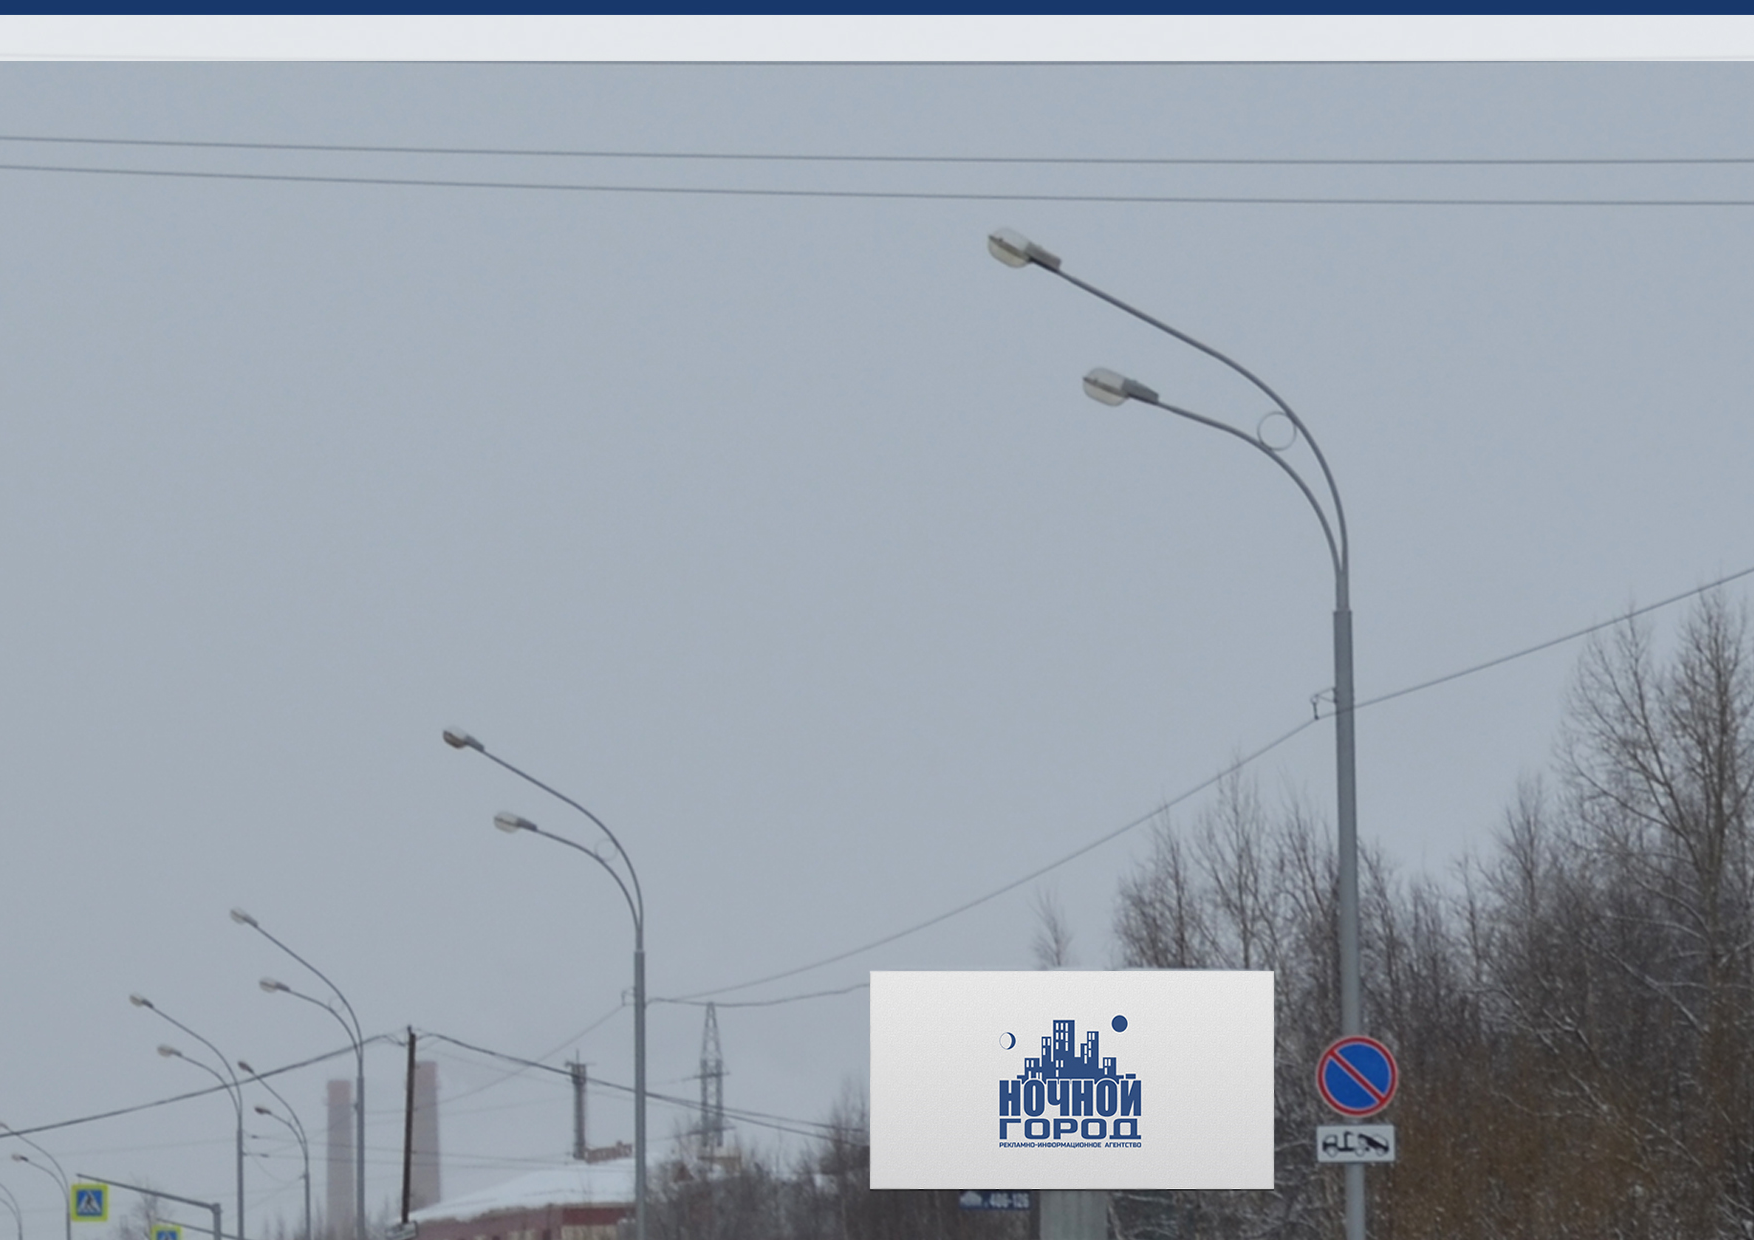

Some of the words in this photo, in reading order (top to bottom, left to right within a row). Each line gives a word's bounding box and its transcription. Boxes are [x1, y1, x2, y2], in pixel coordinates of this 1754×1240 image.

[999, 1073, 1142, 1117] НОЧНОЙ
[999, 1118, 1142, 1140] ГОРОД
[999, 1141, 1102, 1149] РЕКЛАМНО-ИНФОРМАЦИОННОЕ
[1104, 1141, 1142, 1149] АГЕНТСТВО
